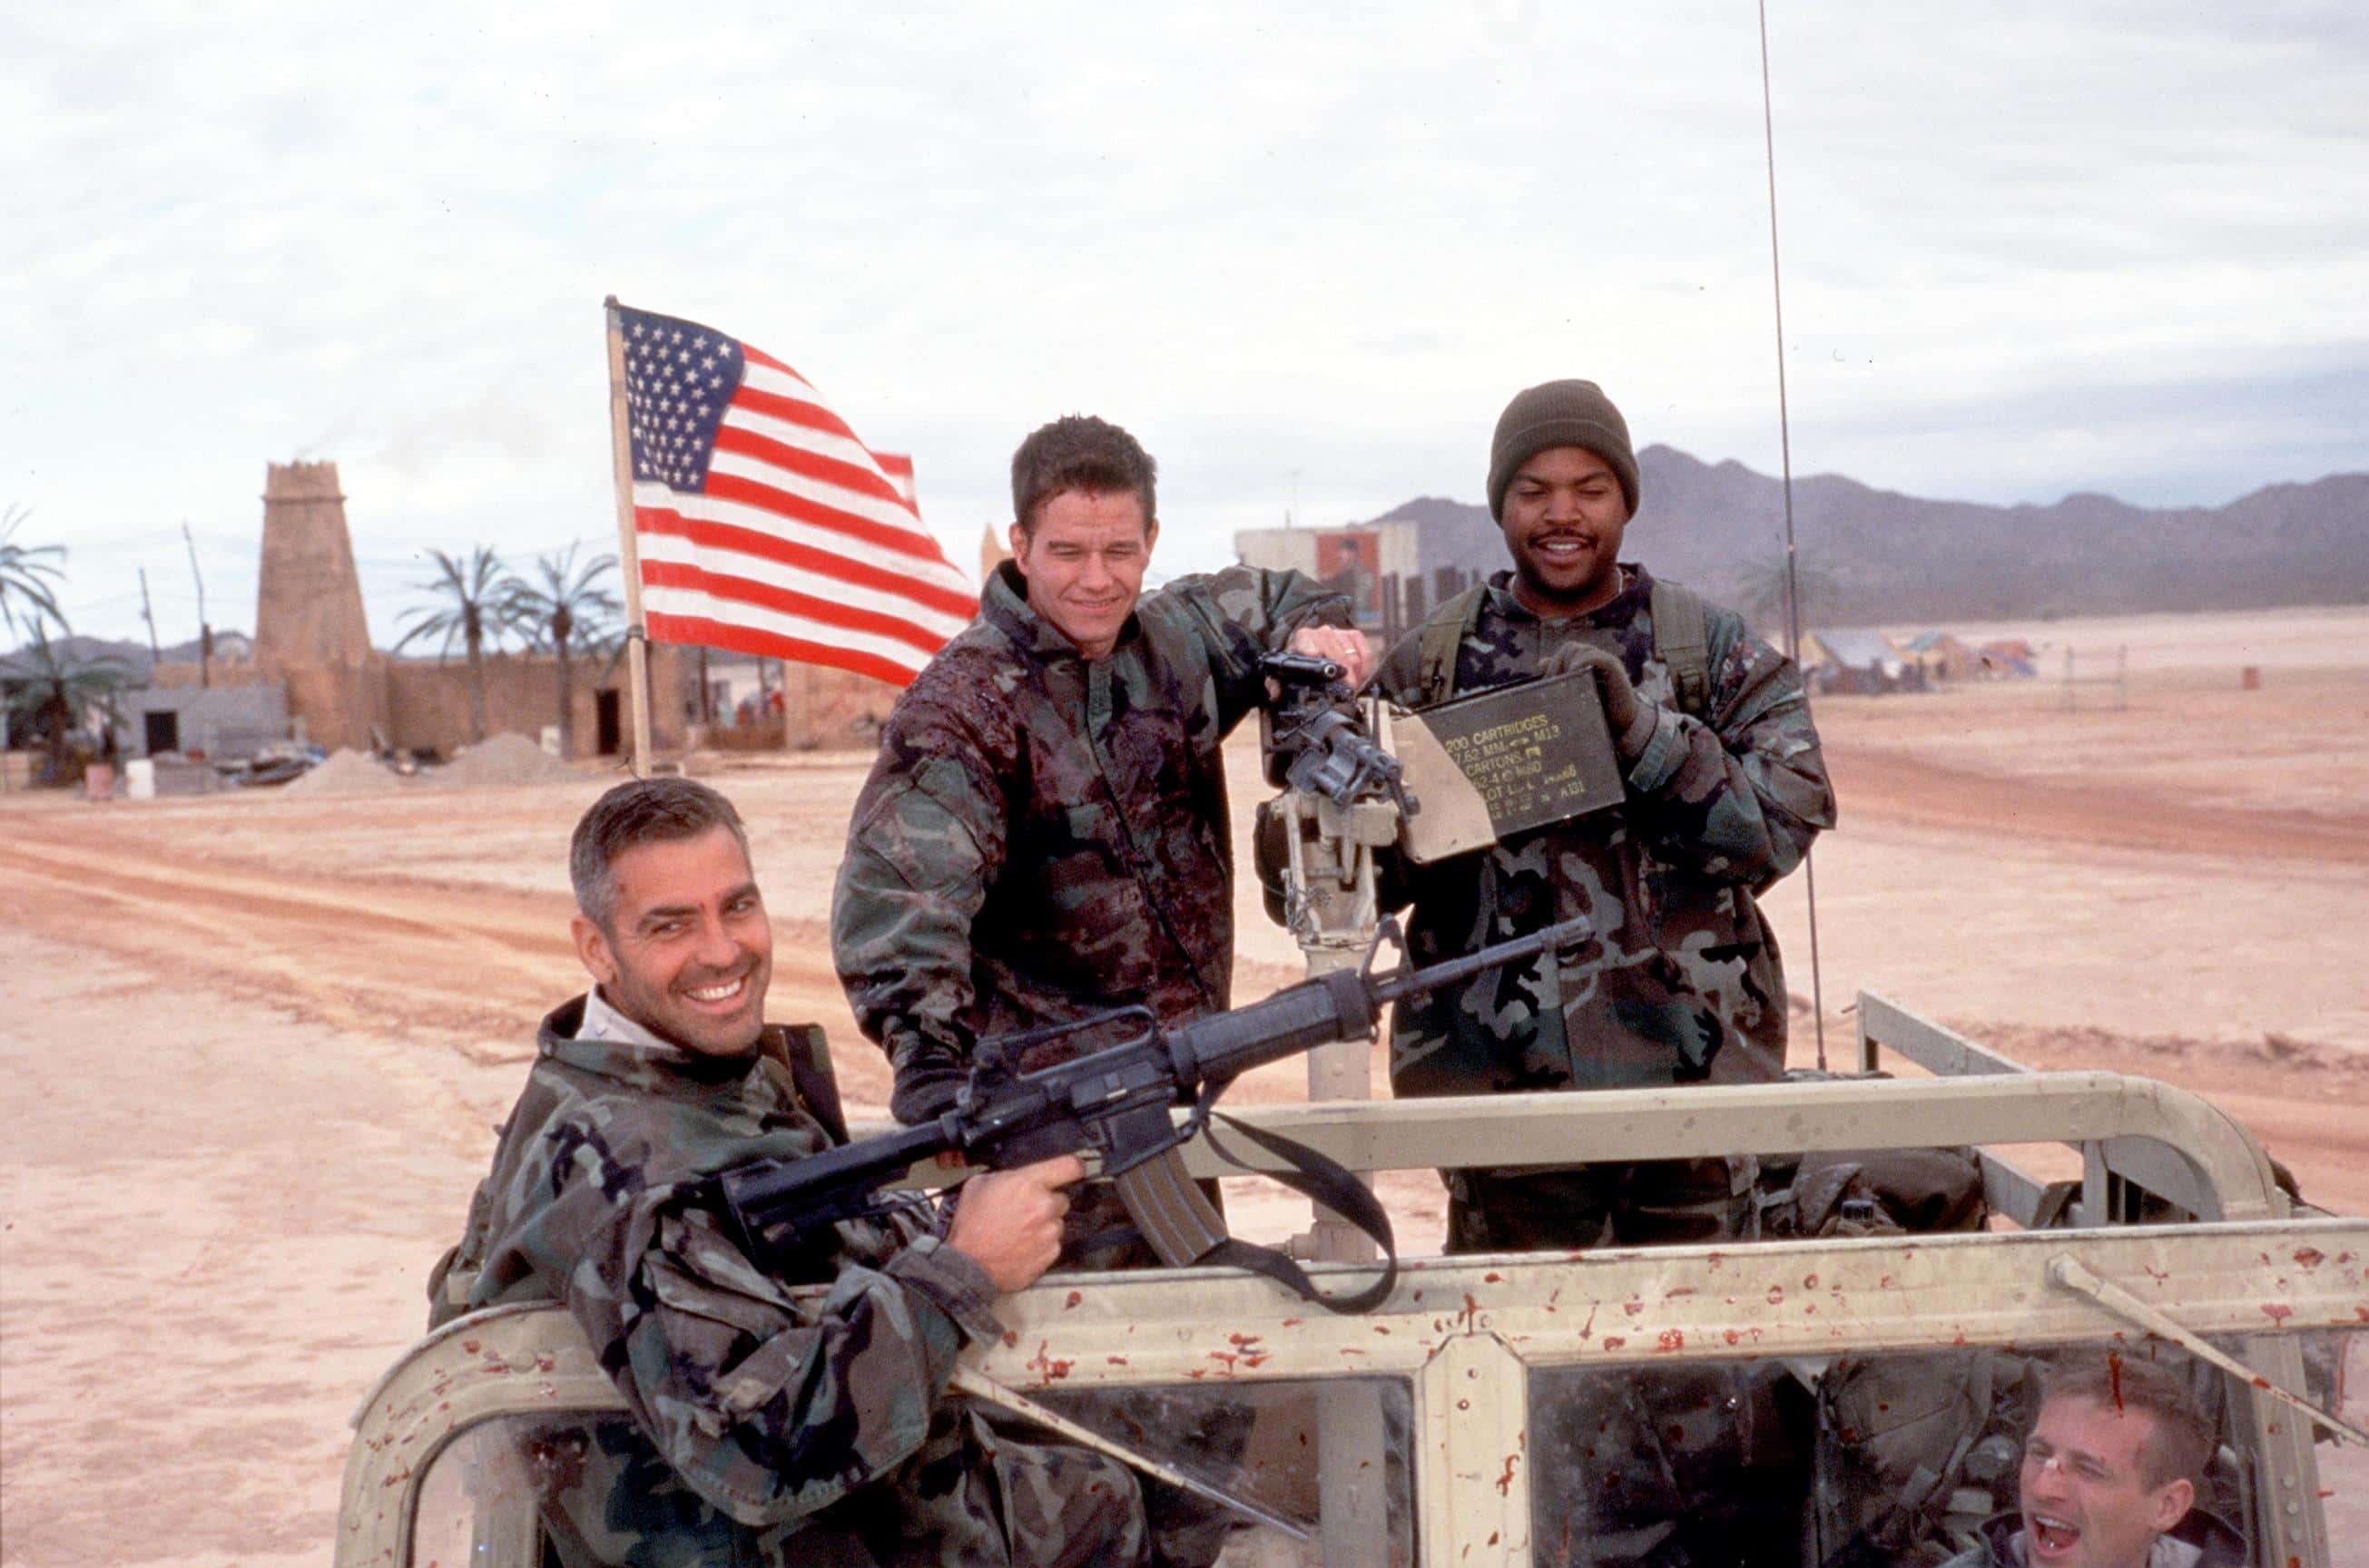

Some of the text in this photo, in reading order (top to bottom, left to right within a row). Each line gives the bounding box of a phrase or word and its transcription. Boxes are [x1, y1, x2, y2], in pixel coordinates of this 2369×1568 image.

[1445, 714, 1548, 752] 200 CARTRIDGES
[1466, 752, 1522, 778] CARTONS
